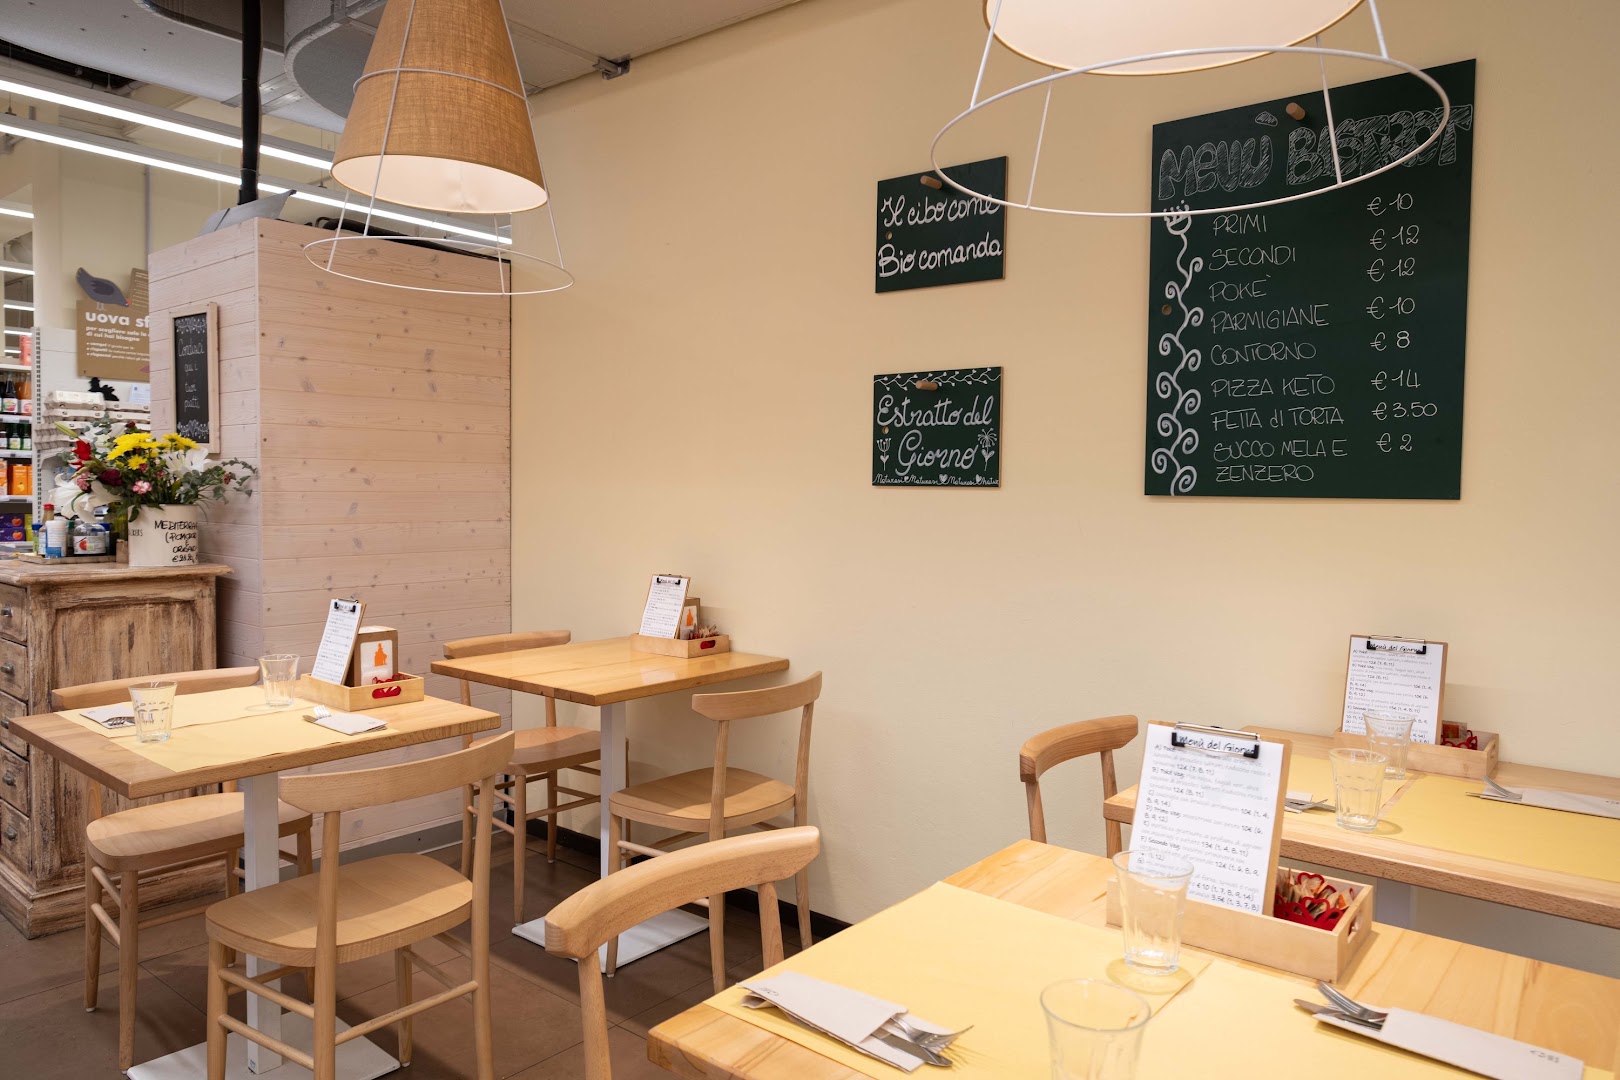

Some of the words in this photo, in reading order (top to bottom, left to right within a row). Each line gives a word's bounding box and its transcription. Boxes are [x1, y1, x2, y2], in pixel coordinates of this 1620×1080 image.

[880, 194, 905, 227] Il
[907, 196, 948, 226] cibo
[947, 194, 1001, 222] come
[1212, 213, 1268, 237] PRIMI
[1391, 192, 1414, 212] 10
[877, 243, 916, 278] Bio
[918, 231, 1003, 271] comanda
[1208, 244, 1296, 272] SECONDI
[1391, 224, 1420, 246] 12
[1390, 257, 1416, 276] 12
[85, 311, 130, 326] uova
[1210, 303, 1330, 334] PARMIGIANE
[1389, 296, 1416, 315] 10
[1210, 341, 1317, 366] CONTORNO
[1396, 329, 1411, 348] 8
[1210, 377, 1274, 398] PIZZA
[1282, 373, 1336, 397] KETO
[1391, 368, 1421, 389] 14
[876, 394, 963, 428] Estratto
[963, 394, 995, 426] del
[1210, 407, 1263, 431] FETTA
[1288, 406, 1345, 427] TORTA
[1392, 401, 1438, 420] 3.50
[895, 429, 979, 476] Giorno
[1213, 440, 1275, 462] SUCCO
[1280, 439, 1327, 458] MELA
[1332, 438, 1348, 458] E
[1399, 433, 1413, 452] 2
[1215, 463, 1315, 483] ZENZERO
[1207, 739, 1222, 751] del
